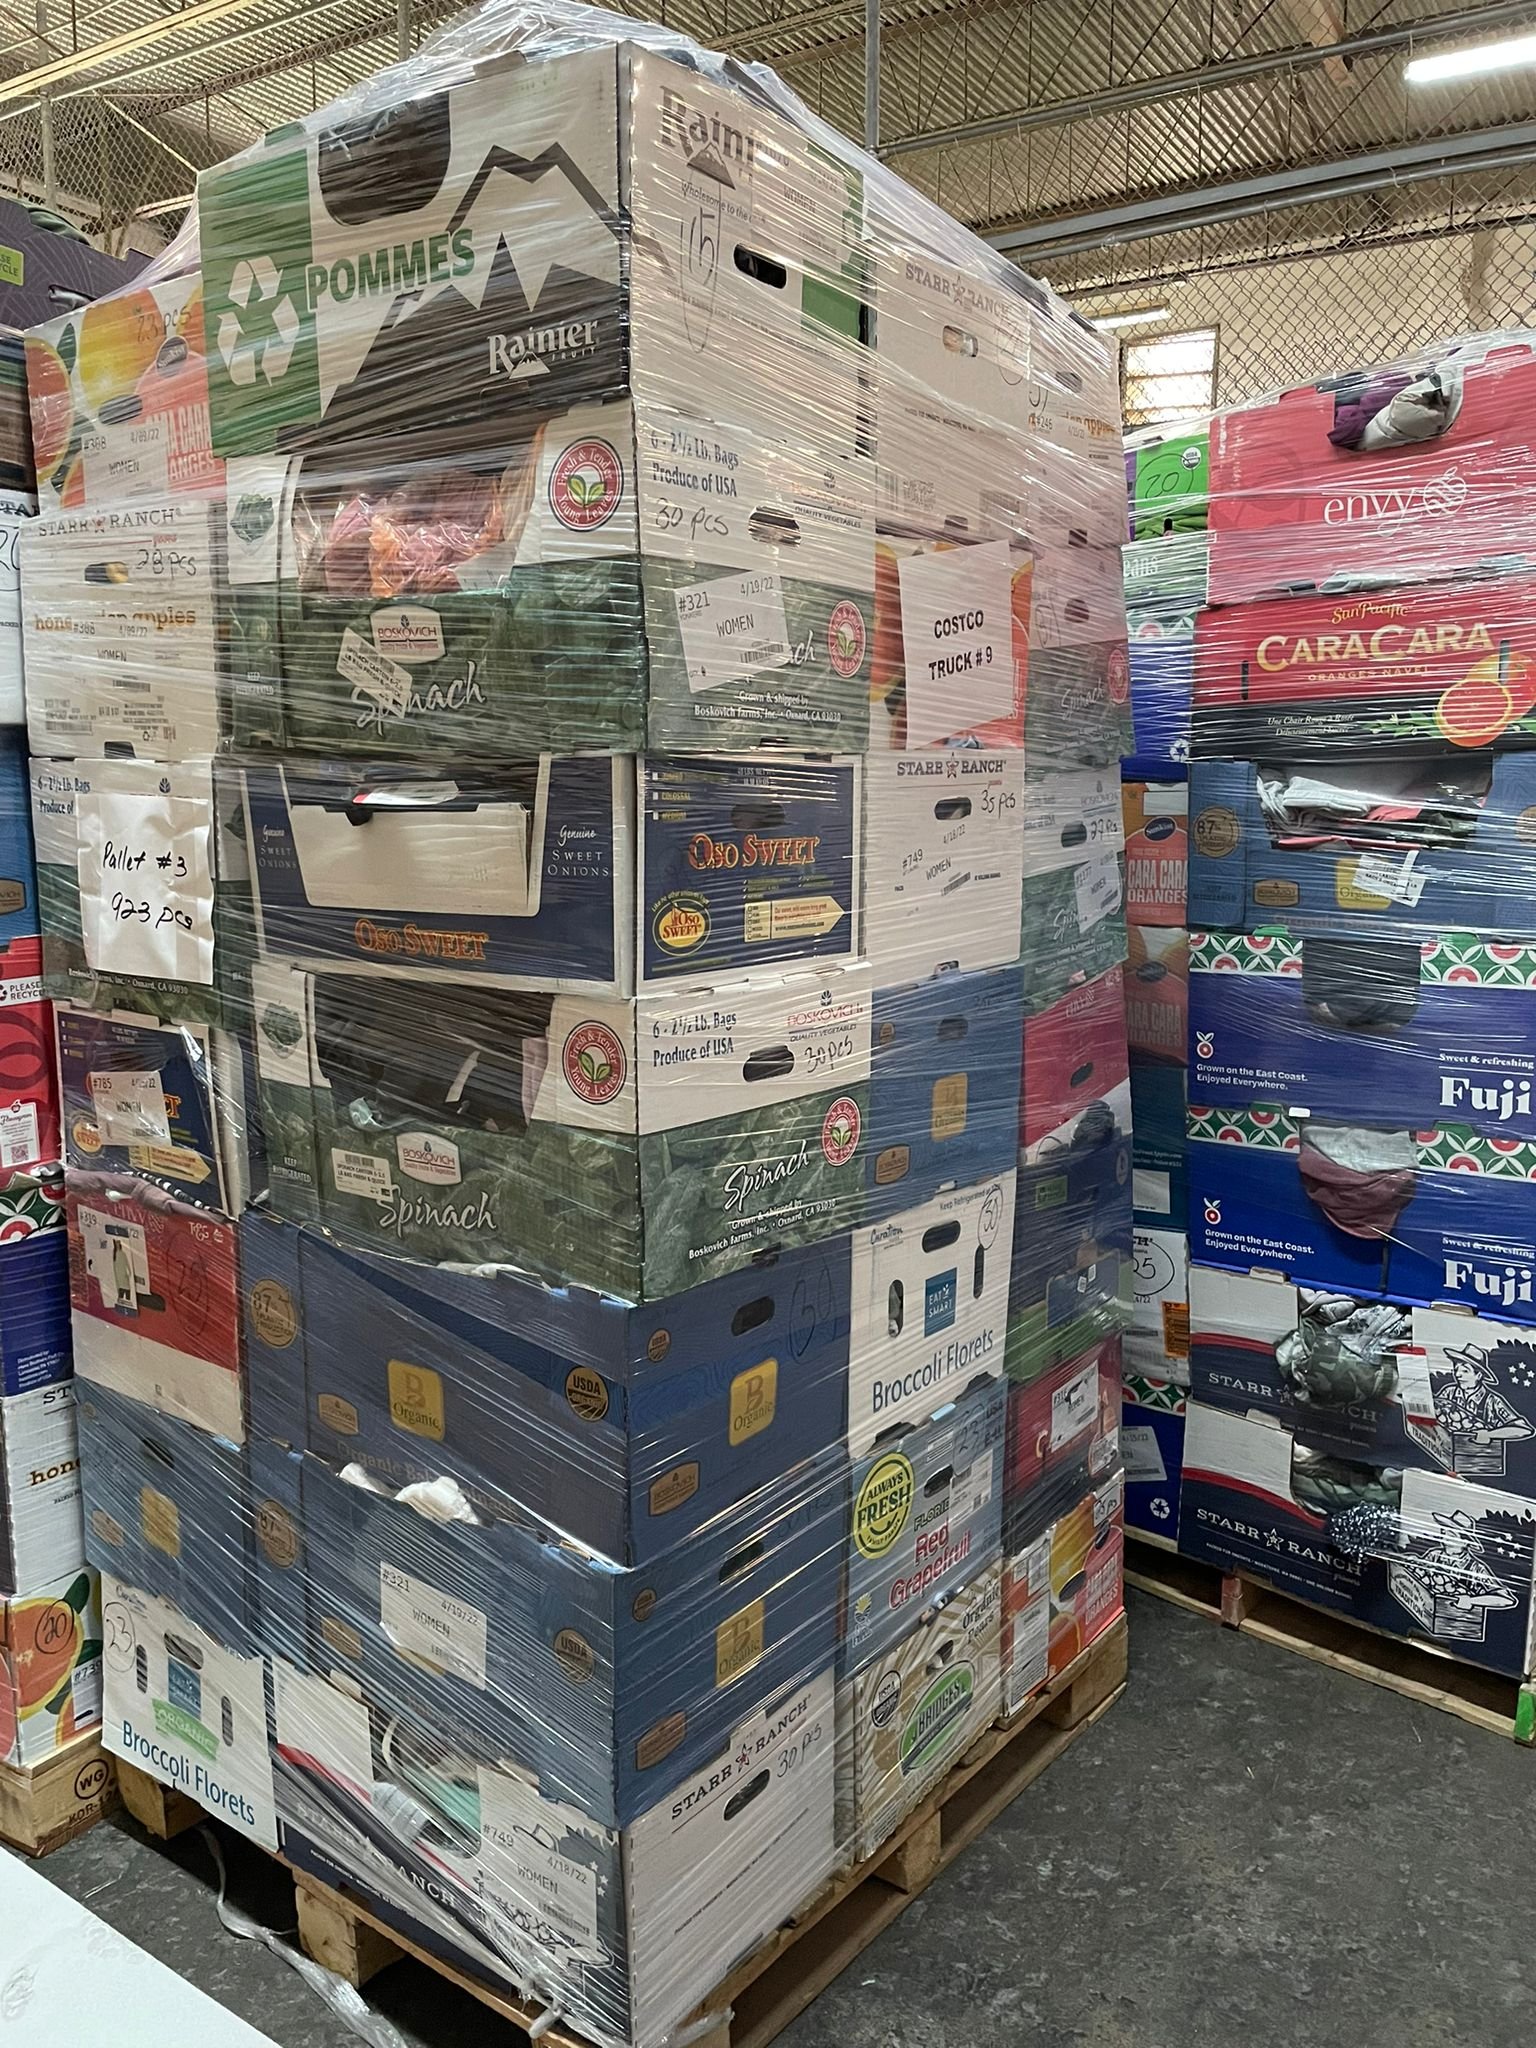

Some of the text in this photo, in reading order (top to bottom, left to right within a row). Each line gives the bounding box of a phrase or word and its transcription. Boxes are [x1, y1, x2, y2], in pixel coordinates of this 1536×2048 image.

[306, 228, 476, 311] POMMES
[905, 262, 950, 295] STARR
[487, 320, 598, 375] Rainier
[109, 461, 141, 476] WOMEN
[714, 443, 739, 470] Bags
[653, 461, 737, 497] Produce of USA
[39, 509, 176, 537] STARR RANCH
[1323, 487, 1421, 537] envy
[678, 576, 775, 613] #321 4/19/22
[378, 626, 437, 639] BOSKOVICH
[716, 613, 755, 638] WOMEN
[933, 609, 985, 640] COSTCO
[97, 650, 127, 662] WOMEN
[928, 652, 974, 681] TRUCK
[985, 646, 993, 665] 9
[1308, 669, 1377, 682] ORANGES
[694, 704, 737, 718] Boskovich
[811, 711, 821, 721] CA
[820, 712, 842, 722] 93030
[897, 760, 1004, 777] STARR RANCH
[40, 801, 64, 814] Produce
[980, 789, 1017, 819] 35 pcs
[558, 824, 596, 846] Genuine
[102, 841, 146, 873] Pallet
[258, 857, 297, 869] ONIONS
[260, 845, 291, 856] SWEET
[551, 849, 603, 862] SWEET
[742, 834, 821, 867] SWEET
[902, 848, 923, 869] #749
[547, 863, 610, 877] ONIONS
[925, 856, 952, 881] WOMEN
[1127, 859, 1188, 889] CARA CARA
[111, 892, 151, 923] 923
[355, 918, 490, 961] OSO SWEET
[662, 924, 702, 940] SWEET
[157, 982, 167, 992] CA
[167, 984, 189, 995] 93030
[653, 1011, 737, 1038] 6 Lb. Bags
[653, 1037, 734, 1067] Produce of USA
[803, 1047, 826, 1074] 30
[1439, 1053, 1534, 1070] Sweet & refreshing
[1196, 1063, 1225, 1073] Grown
[1239, 1068, 1254, 1076] the
[1255, 1069, 1277, 1079] East
[1278, 1071, 1308, 1082] Coast.
[1196, 1073, 1289, 1091] Enjoyed Everywhere.
[1439, 1075, 1533, 1121] Fuji
[402, 1147, 455, 1166] BOSKOVICH
[723, 1139, 810, 1213] Spinach
[375, 1184, 497, 1238] Spinach
[688, 1238, 729, 1260] Boskovich
[805, 1206, 815, 1217] CA
[1205, 1228, 1315, 1255] Grown on the East Coast.
[1205, 1238, 1296, 1261] Enjoyed Everywhere.
[1442, 1236, 1472, 1249] Sweet
[1483, 1244, 1535, 1259] refreshing
[1443, 1257, 1533, 1306] Fuji
[928, 1301, 952, 1319] SMART
[929, 1291, 943, 1306] EAT
[872, 1327, 994, 1414] Broccoli Florets
[572, 1374, 601, 1396] USDA
[1208, 1372, 1273, 1398] STARR
[393, 1401, 442, 1431] Organic
[734, 1400, 775, 1432] Organic
[866, 1472, 904, 1502] ALWAYS
[856, 1482, 912, 1531] FRESH
[914, 1521, 949, 1566] Red
[1196, 1508, 1261, 1540] STARR
[1287, 1540, 1362, 1577] RANCH
[381, 1569, 410, 1593] #321
[888, 1528, 971, 1611] Grapefruit
[412, 1607, 451, 1636] WOMEN
[671, 1696, 810, 1820] STARR RANCH
[776, 1745, 798, 1780] 30
[79, 1769, 105, 1791] WG
[122, 1720, 256, 1826] Broccoli Florets
[482, 1822, 514, 1849] #749
[517, 1862, 559, 1896] WOMEN
